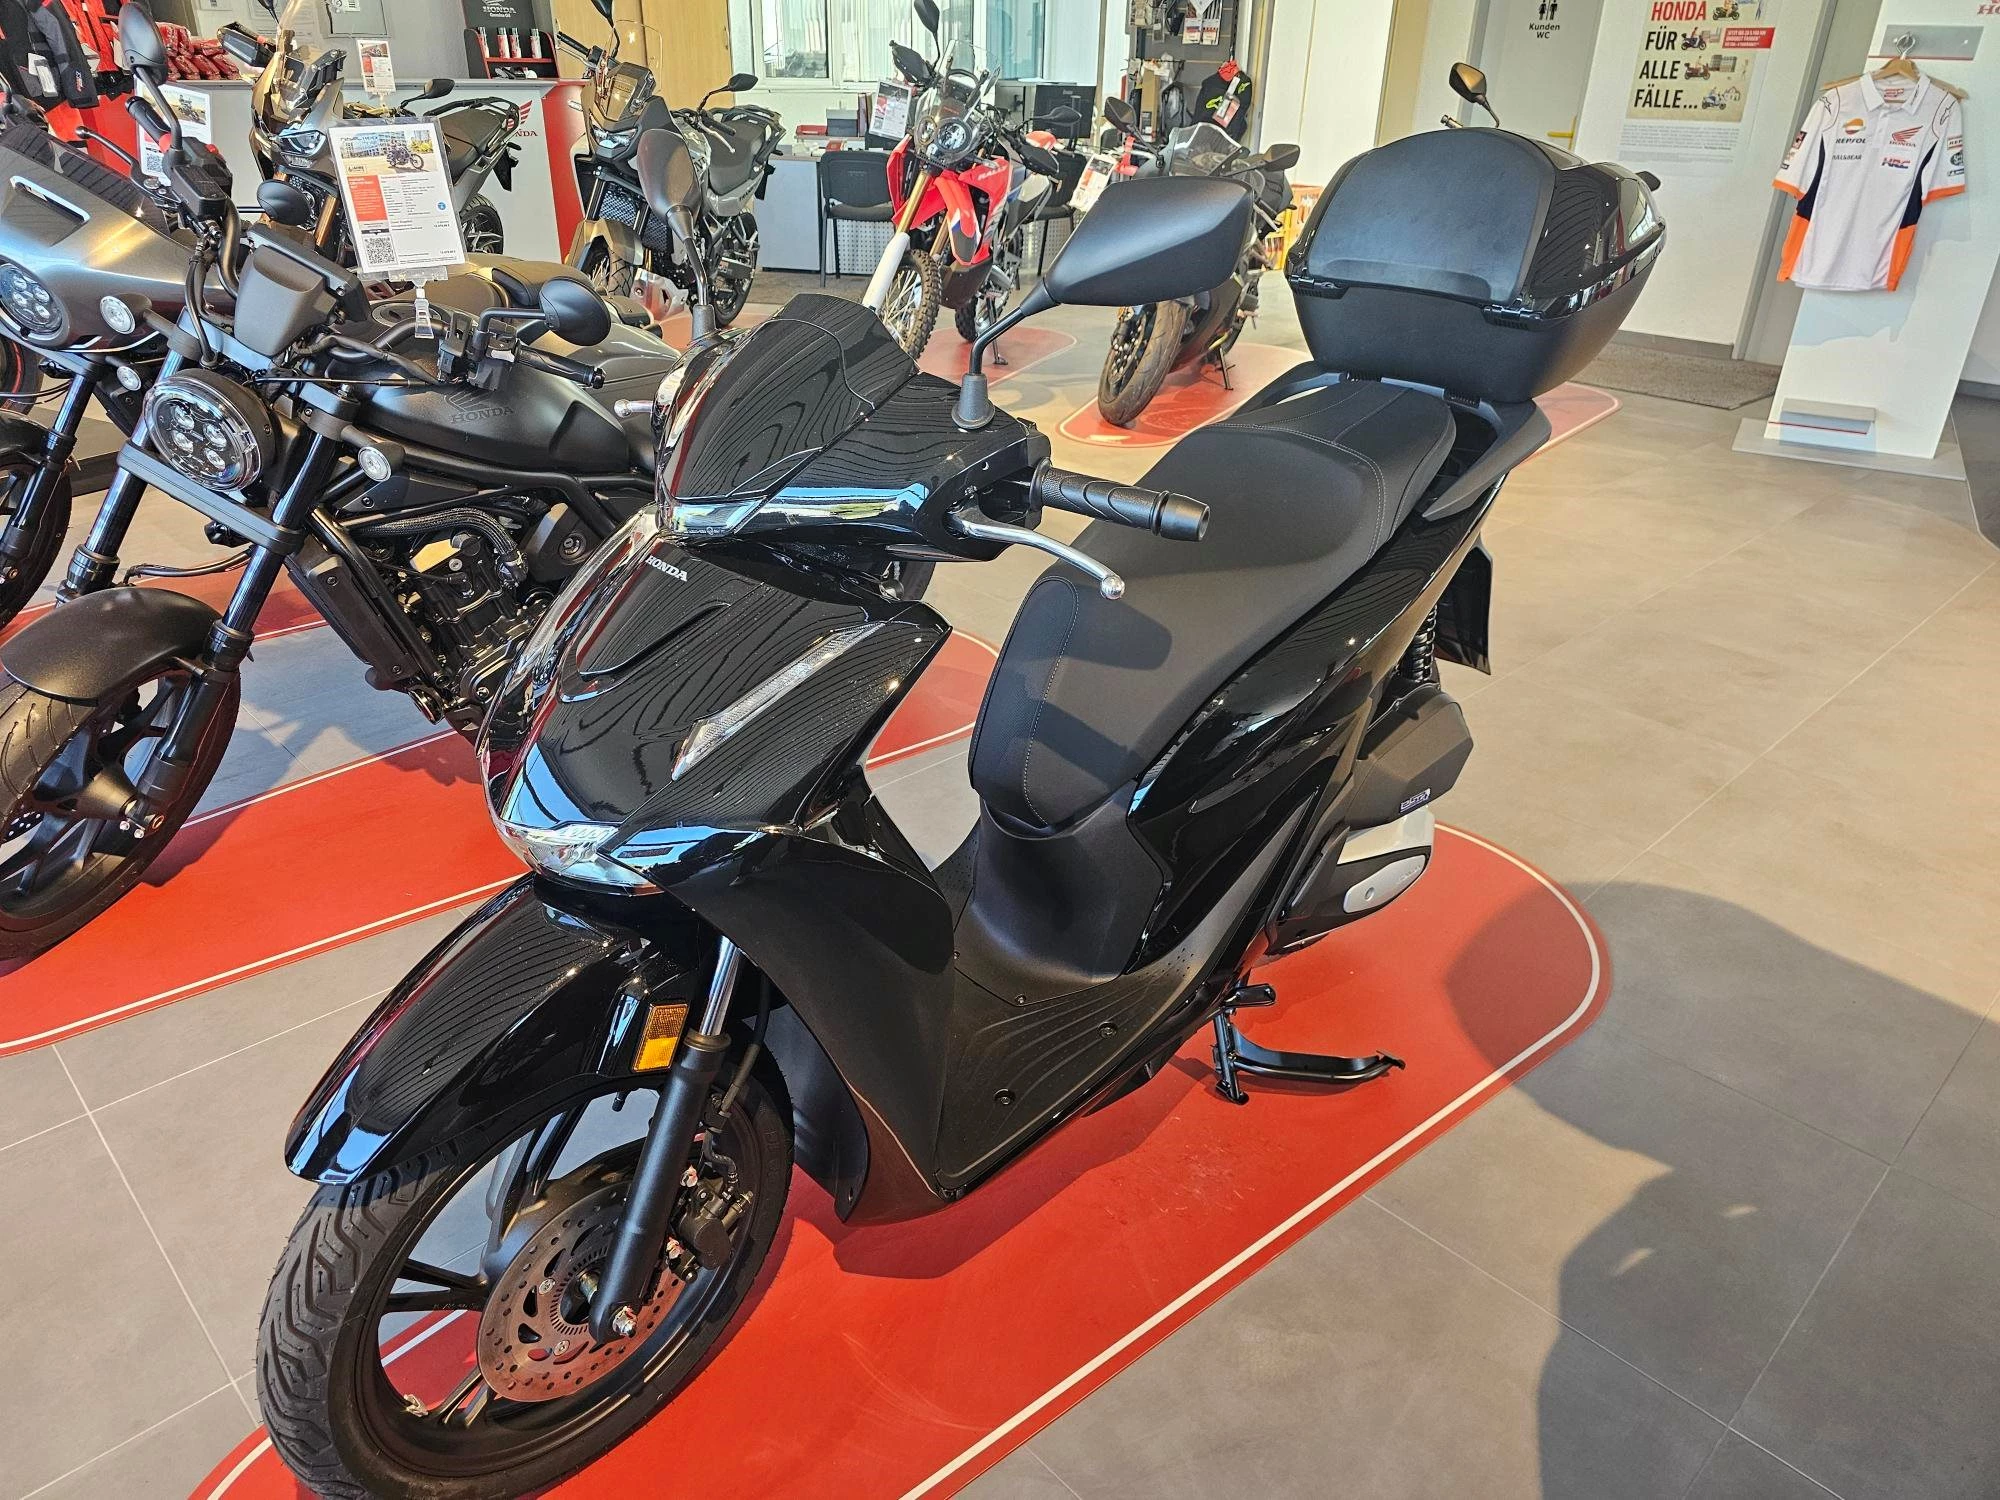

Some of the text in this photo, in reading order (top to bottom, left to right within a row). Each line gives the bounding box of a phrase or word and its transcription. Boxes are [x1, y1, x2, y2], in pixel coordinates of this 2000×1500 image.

[482, 6, 516, 14] HONDA
[1651, 1, 1707, 21] HONDA
[1529, 22, 1560, 31] Kunden
[1537, 31, 1551, 39] WC
[1645, 25, 1678, 51] FÜR
[1639, 60, 1681, 80] ALLE
[1634, 83, 1698, 109] FÄLLE...
[1835, 137, 1866, 145] REPSOL
[1889, 140, 1917, 148] HONDA
[449, 406, 514, 425] HONDA
[644, 555, 688, 582] HONDA
